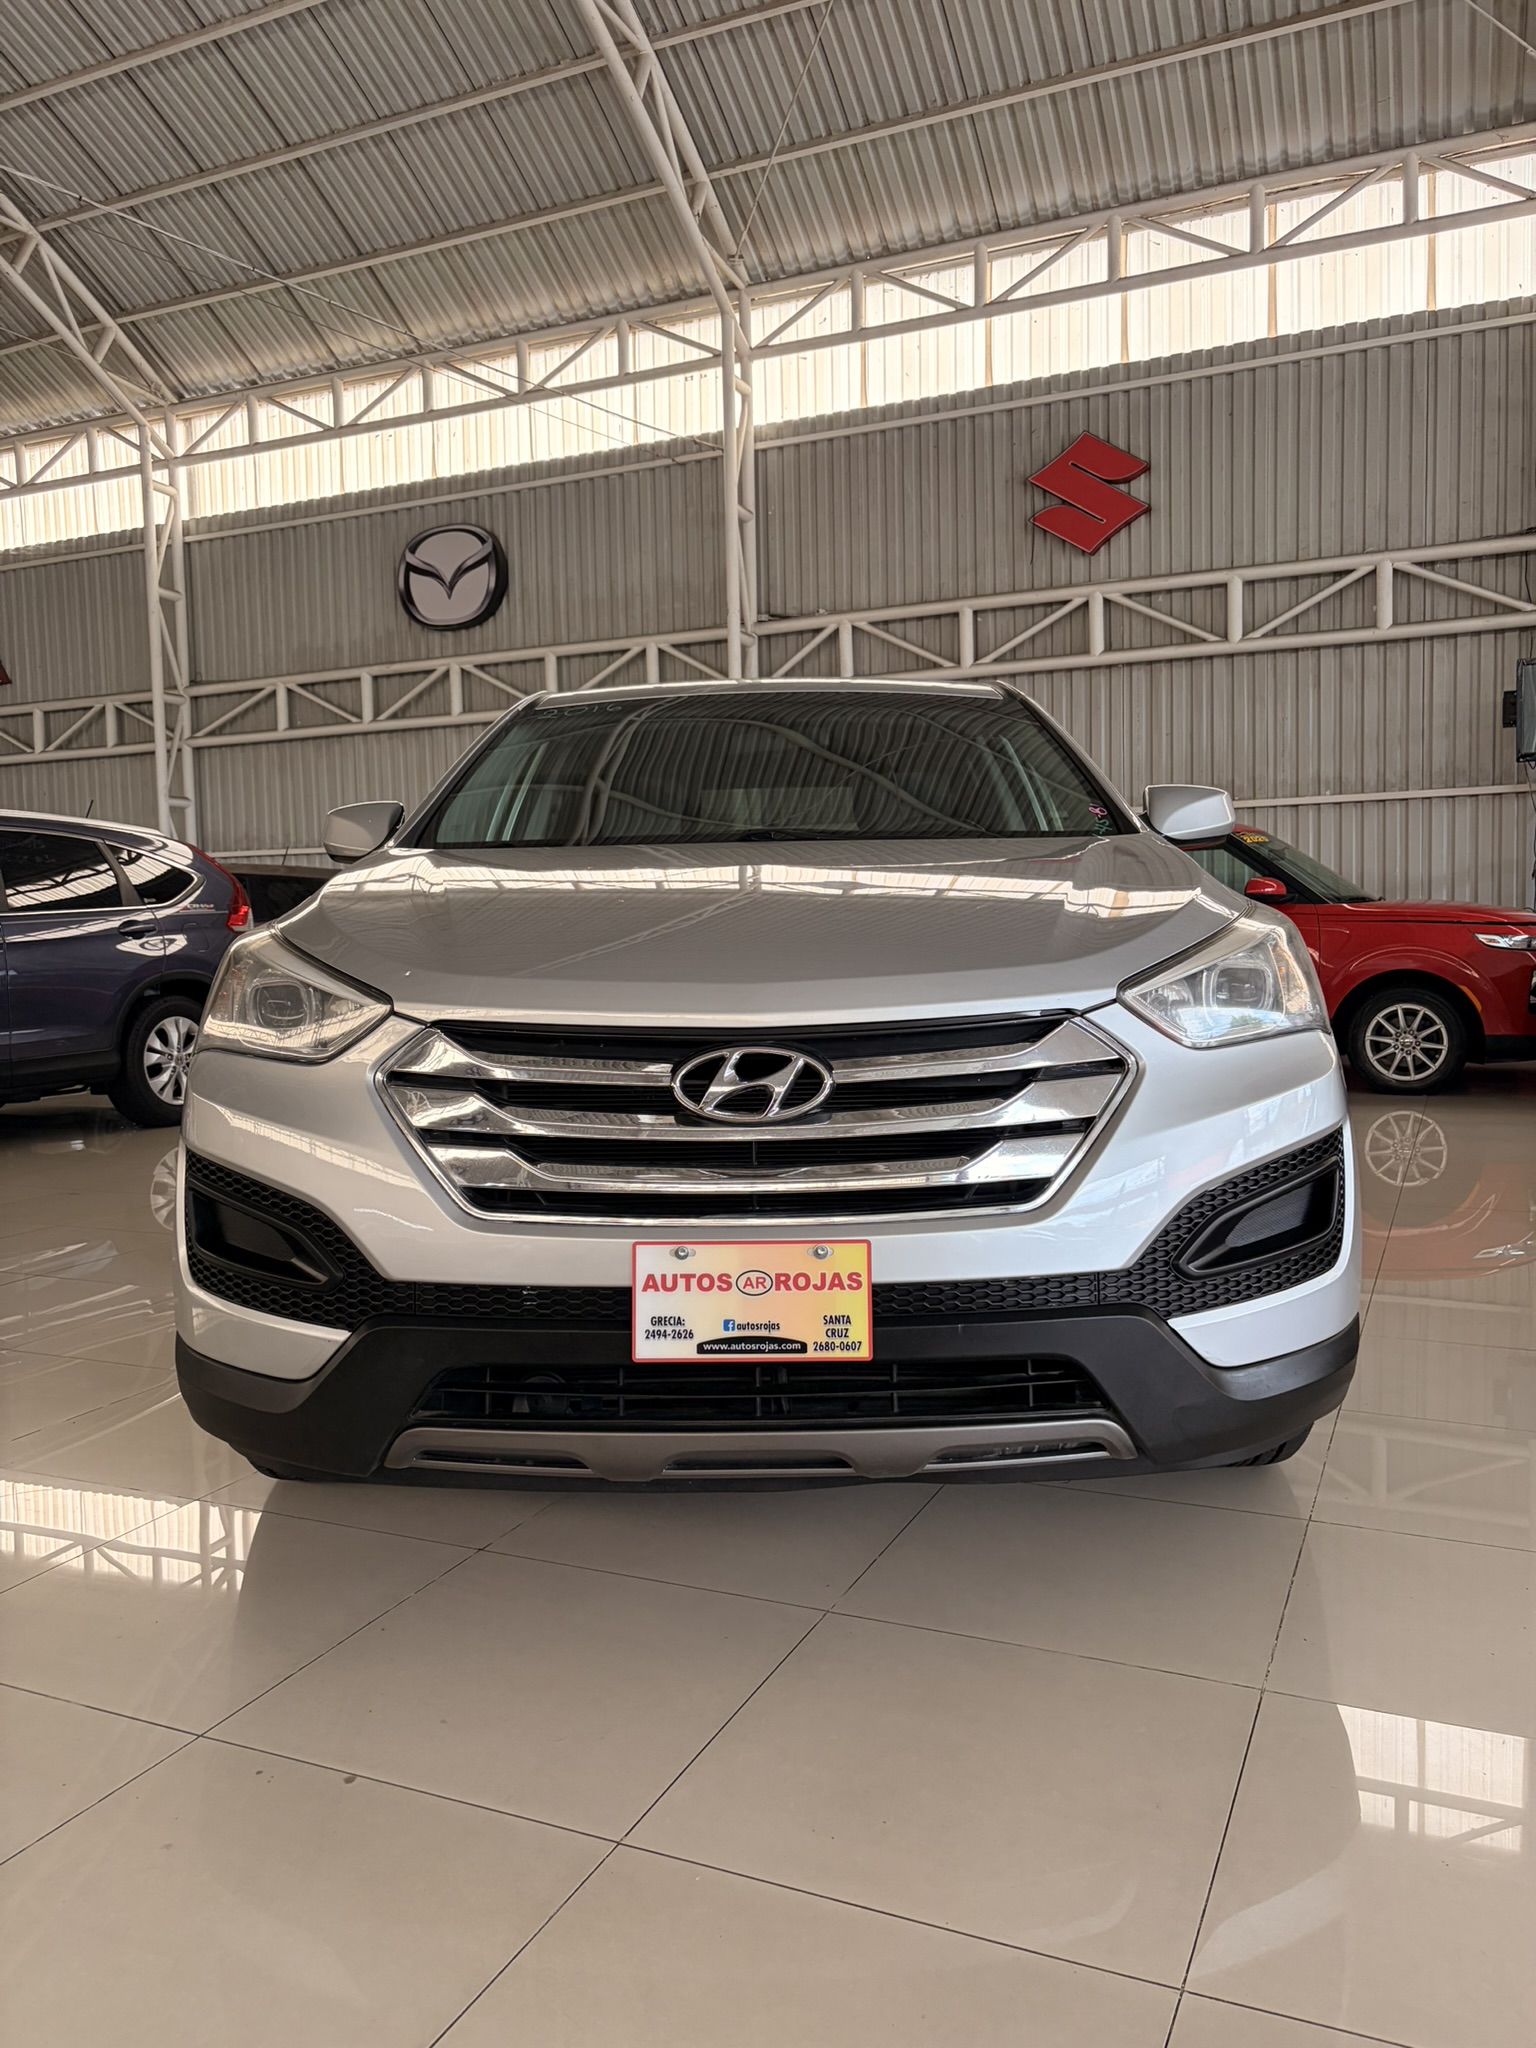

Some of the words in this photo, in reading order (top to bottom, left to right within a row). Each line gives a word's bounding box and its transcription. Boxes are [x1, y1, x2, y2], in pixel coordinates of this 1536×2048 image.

[641, 1273, 733, 1292] AUTOS
[742, 1276, 767, 1290] AR
[774, 1272, 862, 1292] ROJAS
[650, 1316, 685, 1327] GRECIA:
[823, 1315, 851, 1326] SANTA
[736, 1320, 780, 1334] autosrojas
[644, 1329, 694, 1340] 2494-2626
[825, 1328, 849, 1339] CRUZ
[703, 1341, 801, 1352] www.autosrojas.com
[812, 1341, 862, 1352] 2680-0607
